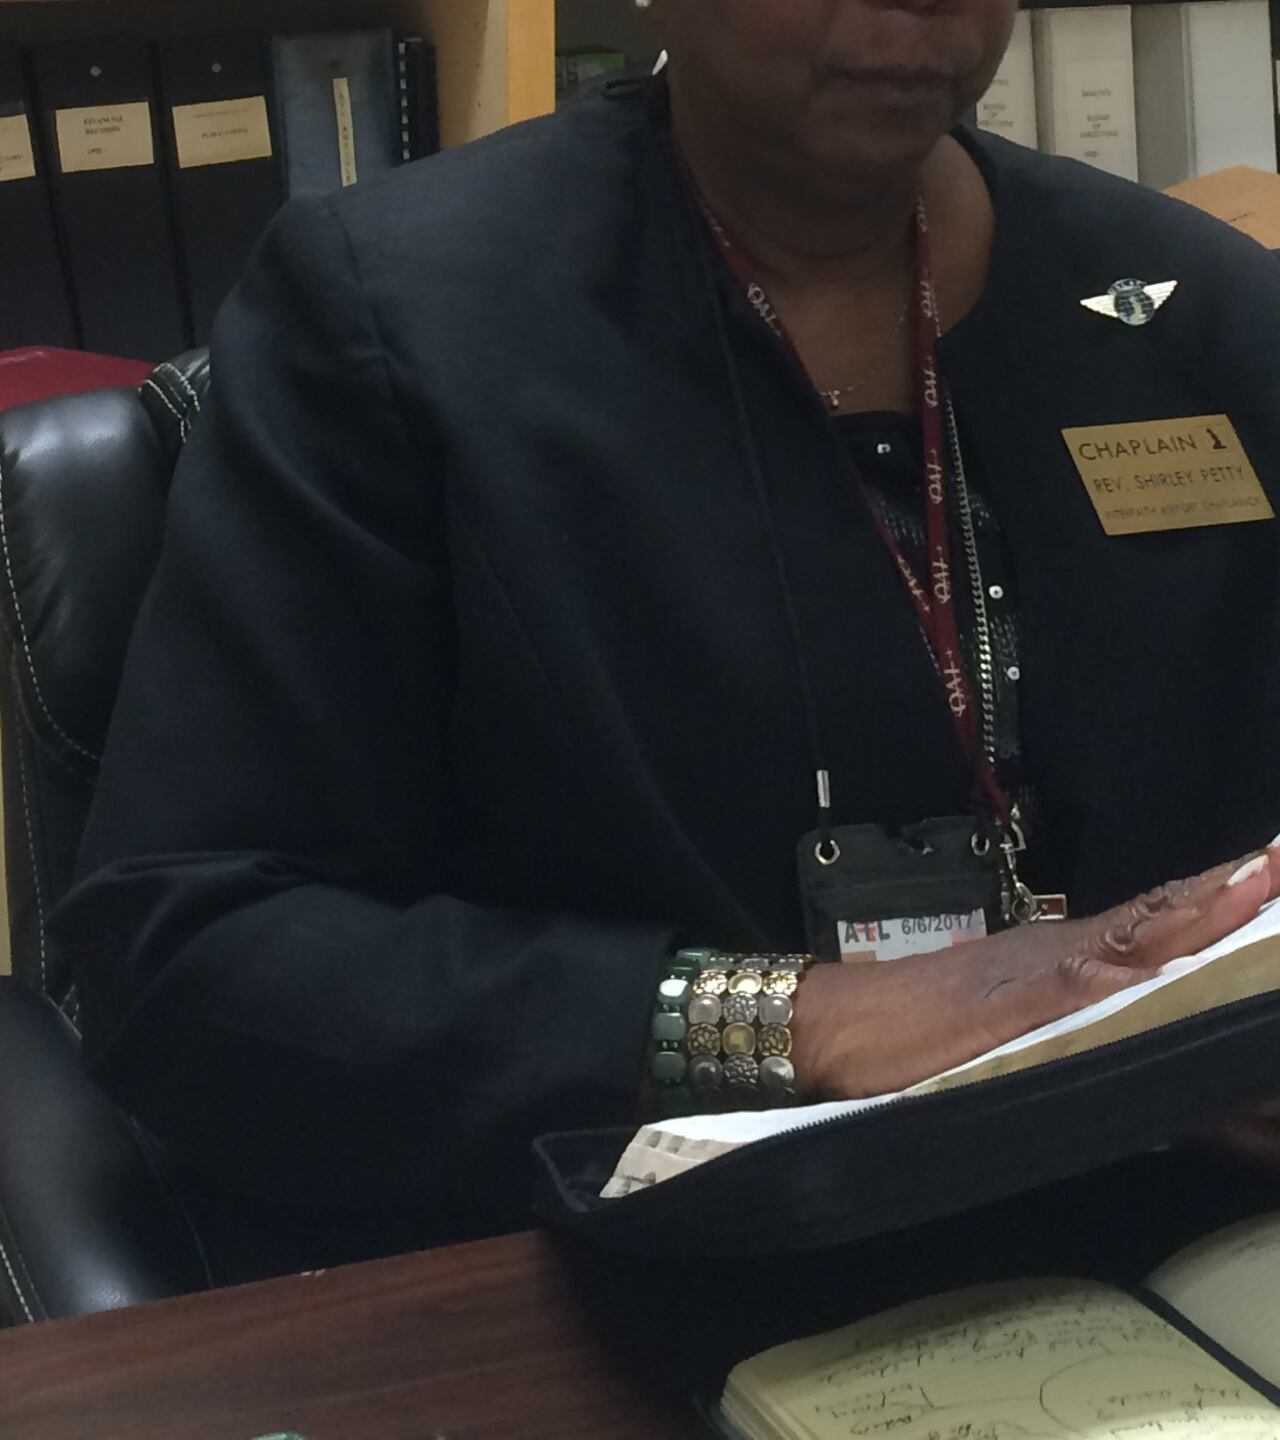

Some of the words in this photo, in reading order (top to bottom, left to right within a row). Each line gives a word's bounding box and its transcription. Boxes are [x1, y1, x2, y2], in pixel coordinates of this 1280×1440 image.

[1078, 434, 1197, 461] CHAPLAIN
[1092, 477, 1130, 494] REV.
[1133, 470, 1194, 490] SHIRLEY
[1200, 465, 1244, 483] PETTY
[844, 921, 891, 944] ATL
[901, 914, 973, 935] 6/6/2017
